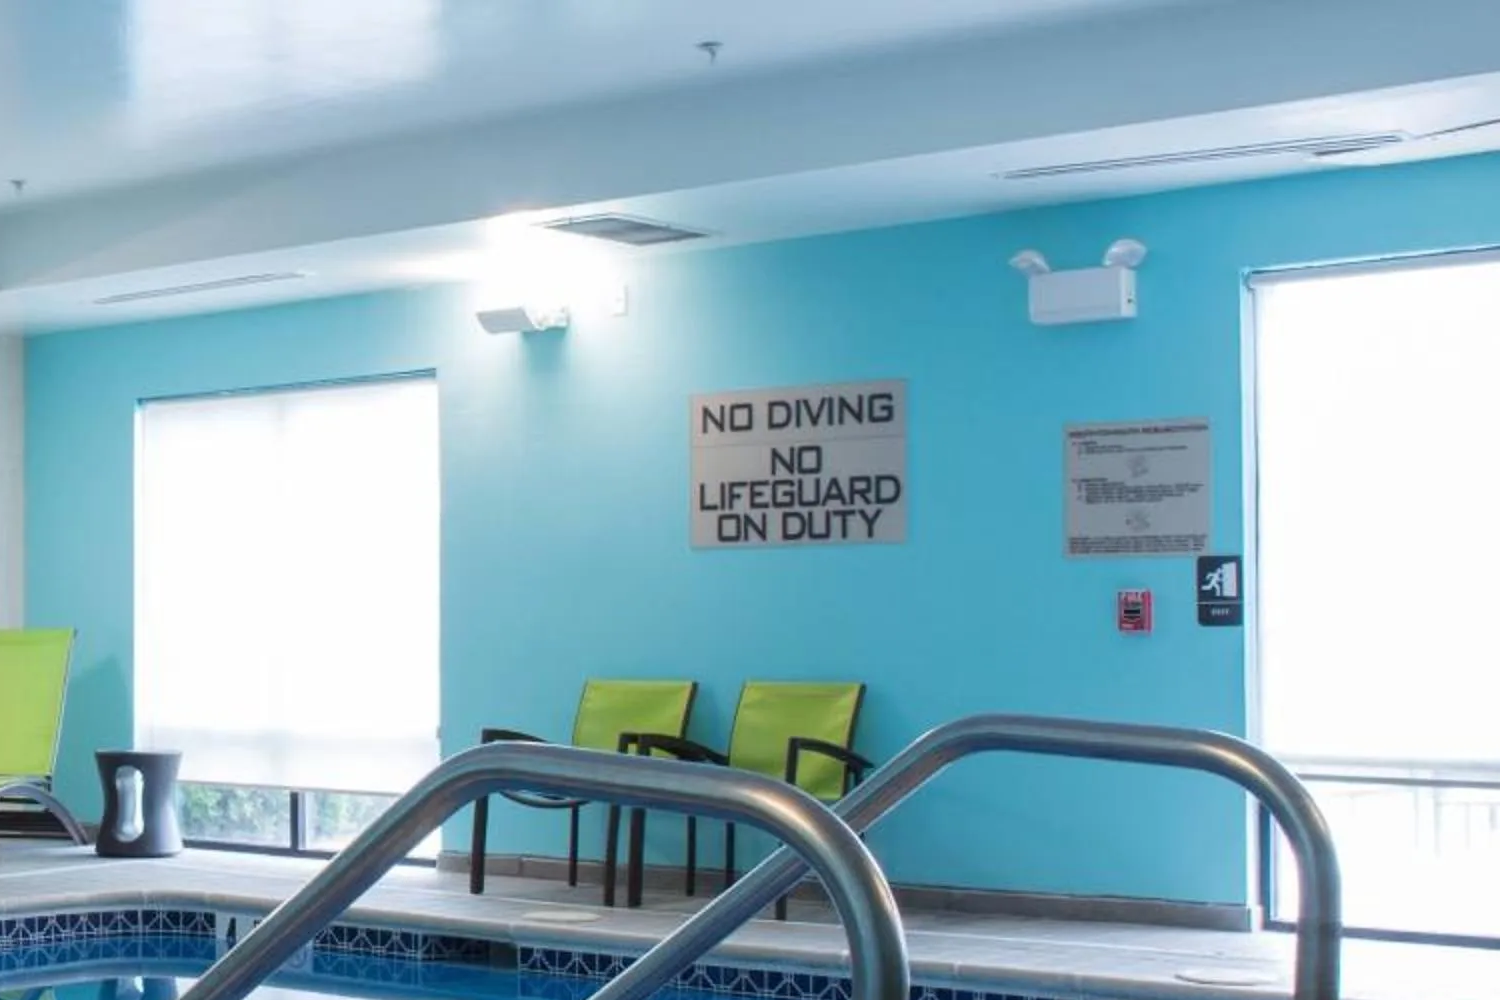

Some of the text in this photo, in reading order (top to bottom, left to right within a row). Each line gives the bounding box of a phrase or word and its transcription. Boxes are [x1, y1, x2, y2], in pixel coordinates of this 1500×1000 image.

[702, 393, 894, 434] NO DIVING
[771, 445, 822, 475] NO
[700, 475, 901, 511] LIFEGUARD
[718, 509, 883, 542] ON DUTY
